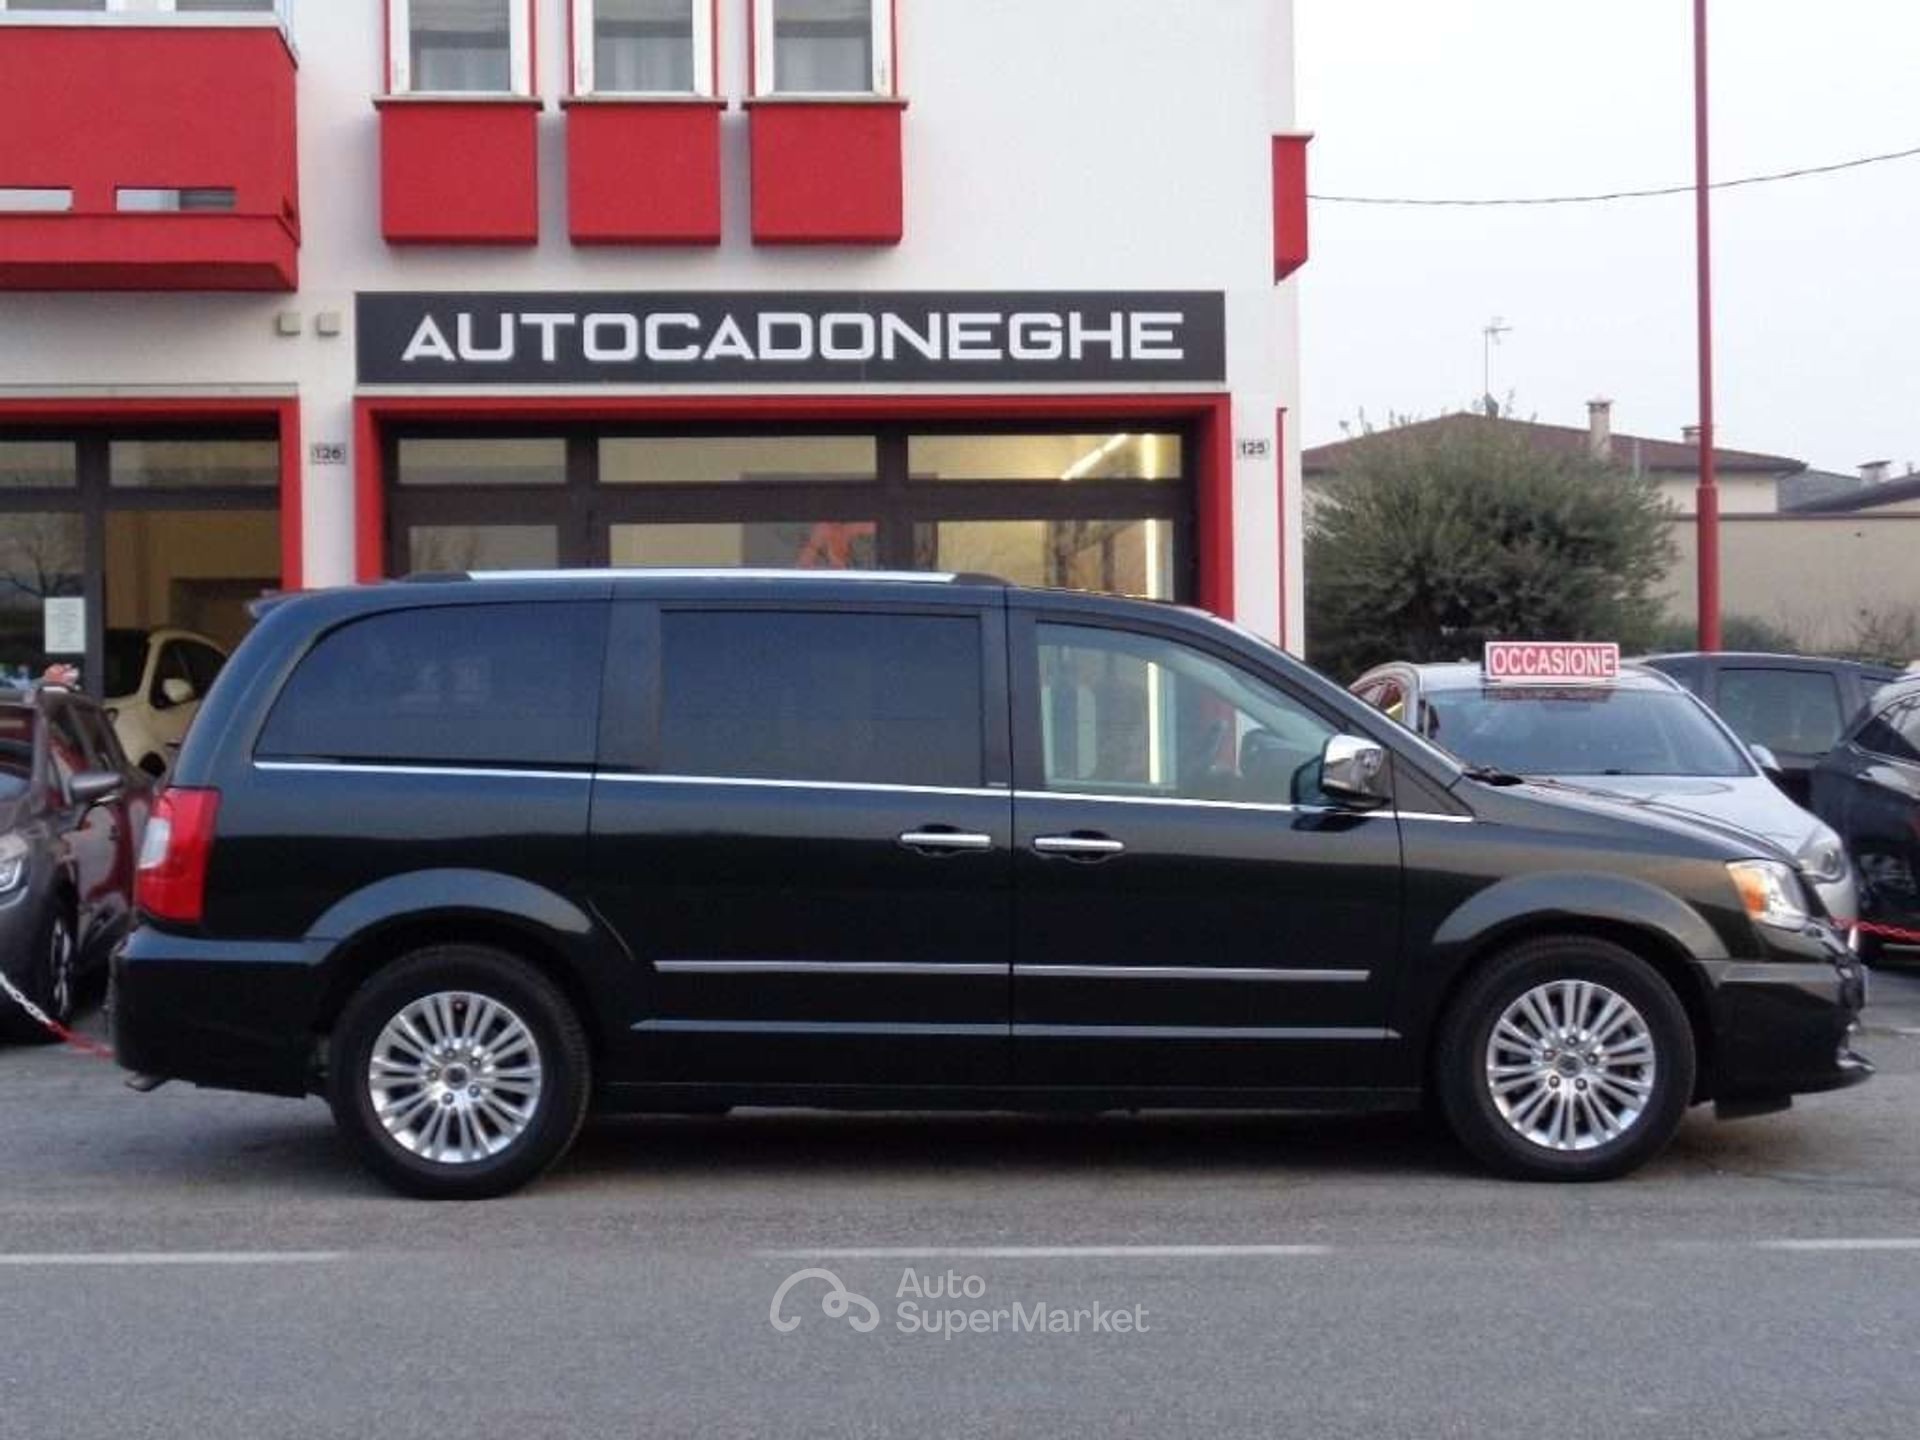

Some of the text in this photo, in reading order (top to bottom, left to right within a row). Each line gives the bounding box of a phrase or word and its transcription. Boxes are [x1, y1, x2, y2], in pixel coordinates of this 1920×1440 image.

[401, 312, 1185, 361] AUTOCADONEGHE
[1241, 440, 1265, 455] 125
[1492, 647, 1614, 674] OCCASIONE
